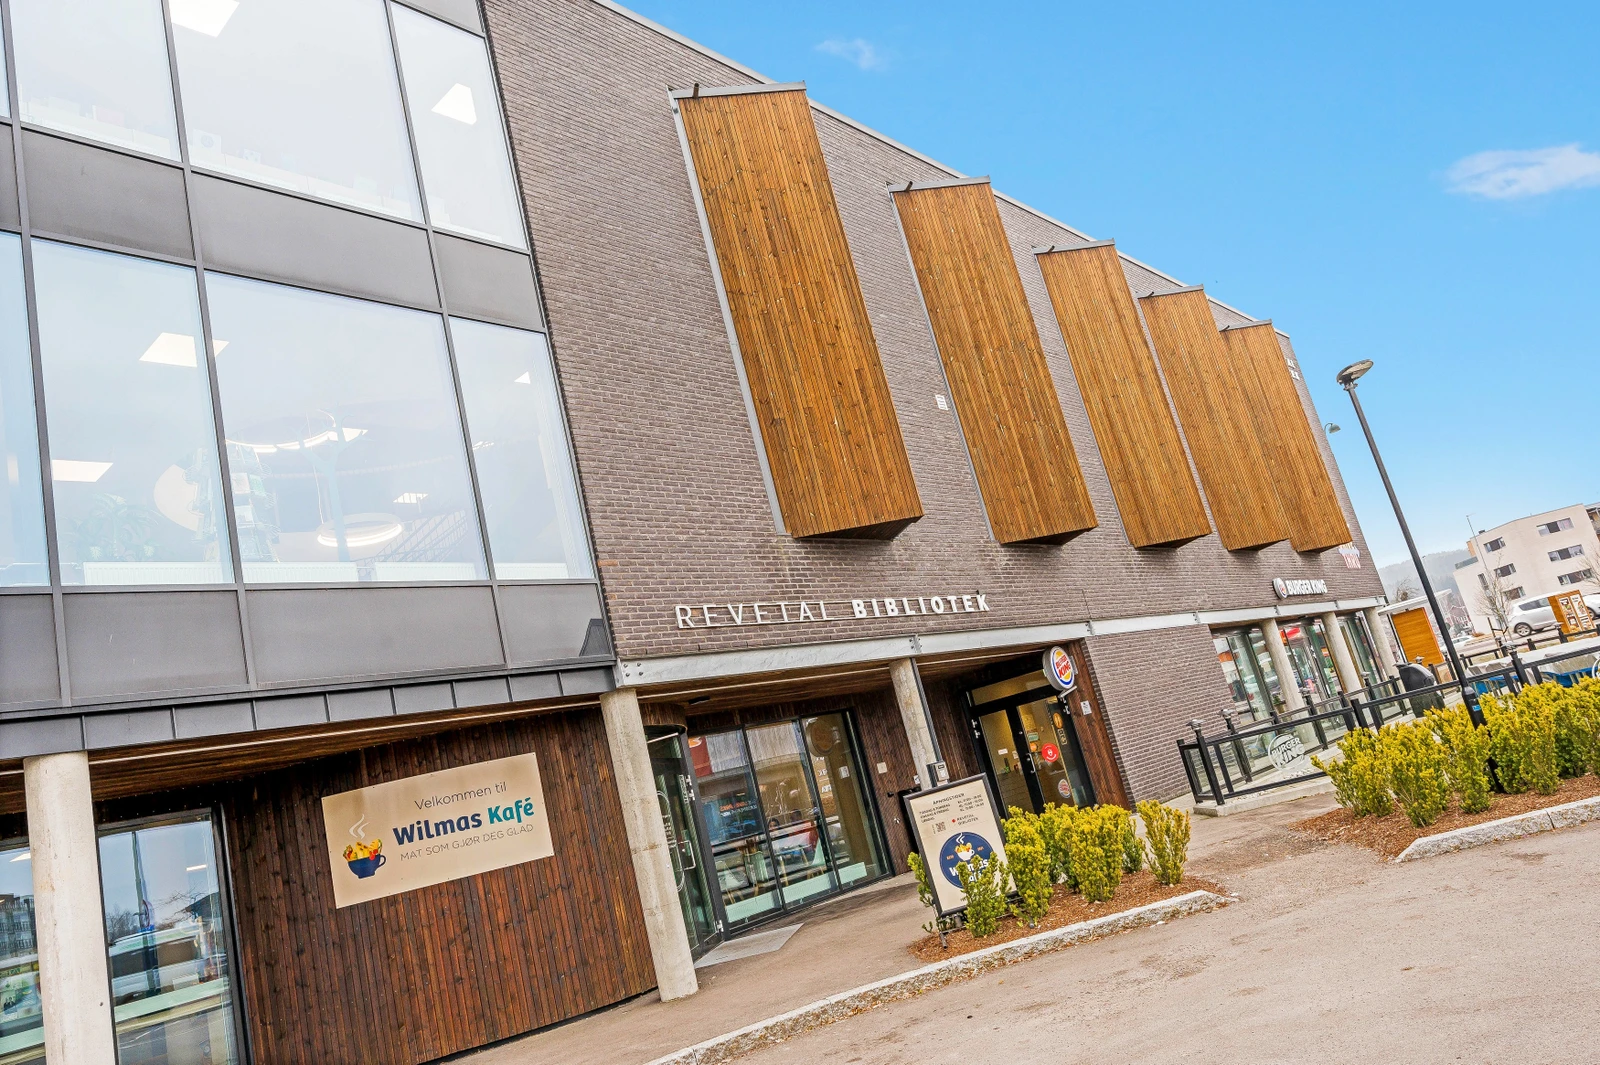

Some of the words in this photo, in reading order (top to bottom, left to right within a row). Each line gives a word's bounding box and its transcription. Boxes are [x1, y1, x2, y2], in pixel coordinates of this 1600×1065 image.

[675, 601, 834, 629] REVETAL
[852, 594, 990, 618] BIBLIOTEK
[1271, 737, 1302, 758] BURGER
[1276, 743, 1305, 767] KING
[414, 787, 491, 810] Velkommen
[494, 781, 508, 793] til
[393, 812, 482, 845] Wilmas
[487, 797, 535, 824] Kafé
[400, 848, 423, 862] MAT
[425, 842, 449, 856] SOM
[451, 835, 480, 850] GJØR
[482, 830, 505, 843] DEG
[507, 824, 534, 837] GLAD
